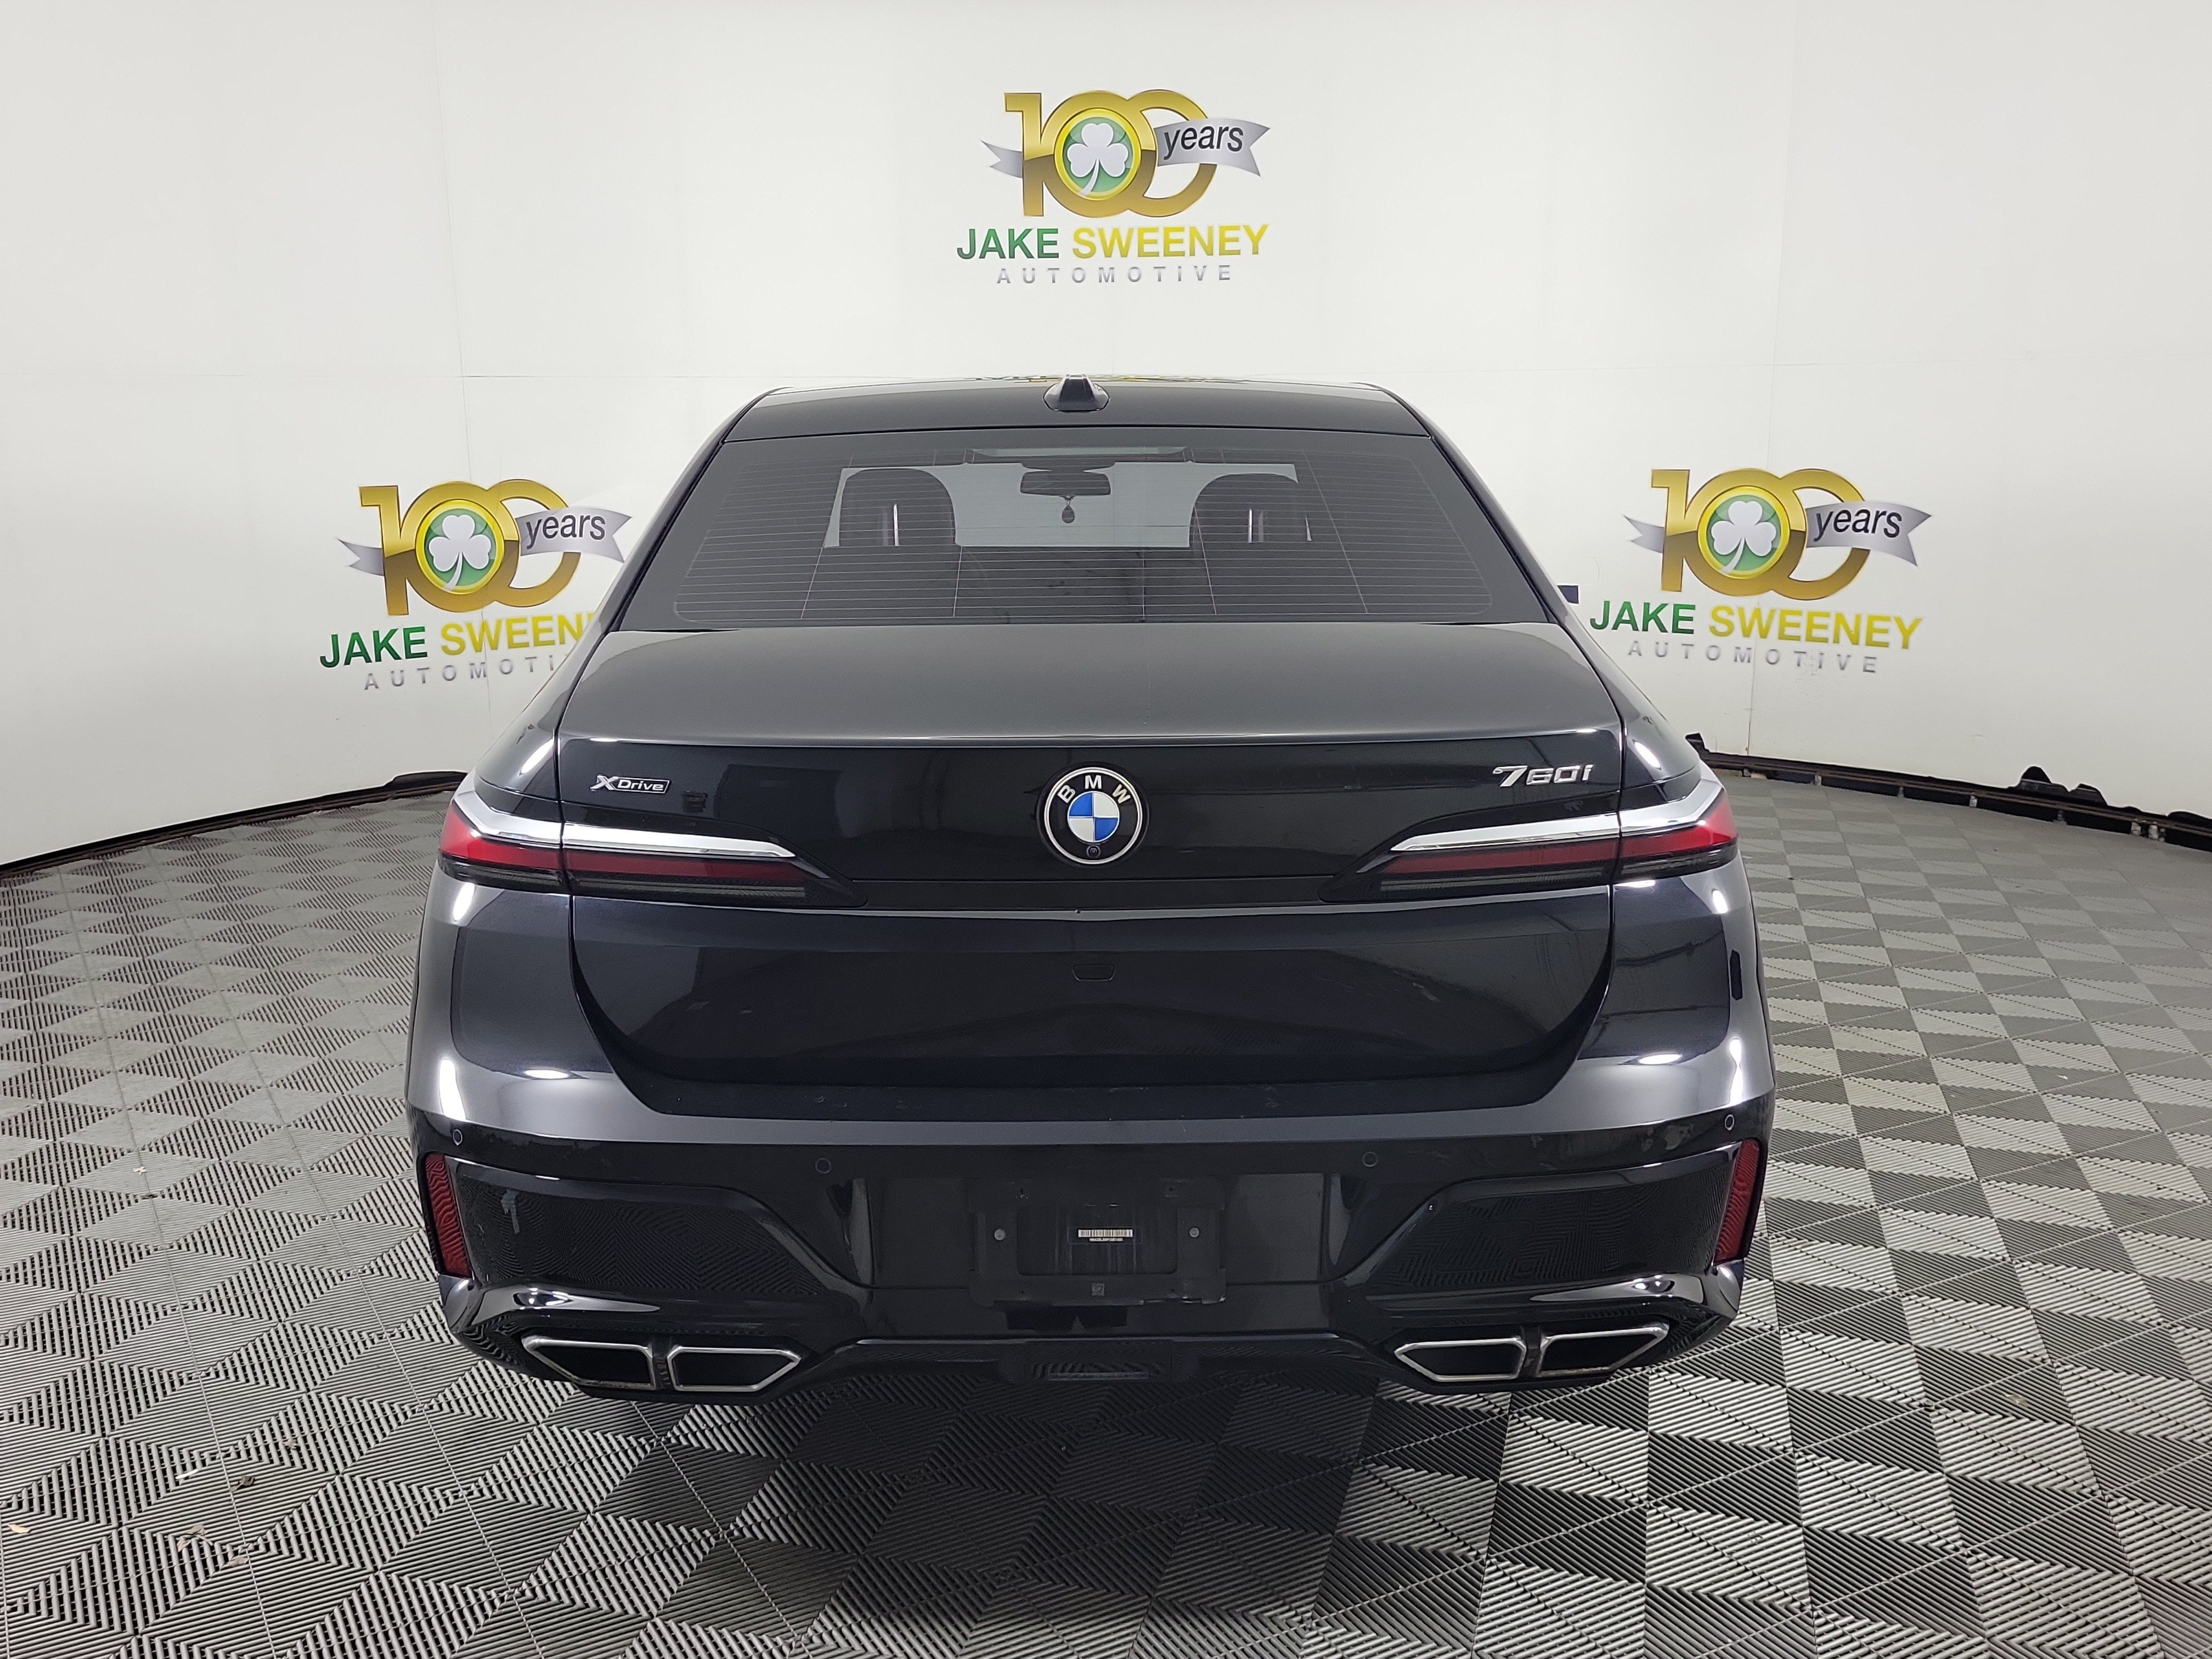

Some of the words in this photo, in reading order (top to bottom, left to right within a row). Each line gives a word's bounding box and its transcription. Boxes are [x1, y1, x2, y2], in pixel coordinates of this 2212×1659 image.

[1003, 89, 1217, 218] 100
[1163, 125, 1244, 160] years
[956, 227, 1059, 260] JAKE
[1072, 224, 1268, 259] SWEENEY
[996, 264, 1231, 284] AUTOMOTIVE
[358, 479, 582, 616] 100
[525, 514, 606, 550] years
[1651, 467, 1871, 601] 100
[1813, 508, 1902, 542] years
[319, 626, 428, 668] JAKE
[441, 612, 595, 656] SWEEN
[1590, 600, 1696, 635] JAKE
[1708, 605, 1923, 650] SWEENEY
[364, 654, 568, 691] AUTOMOTI
[1628, 641, 1877, 673] AUTOMOTIVE
[1057, 775, 1131, 804] BMW
[1492, 764, 1594, 788] 760i
